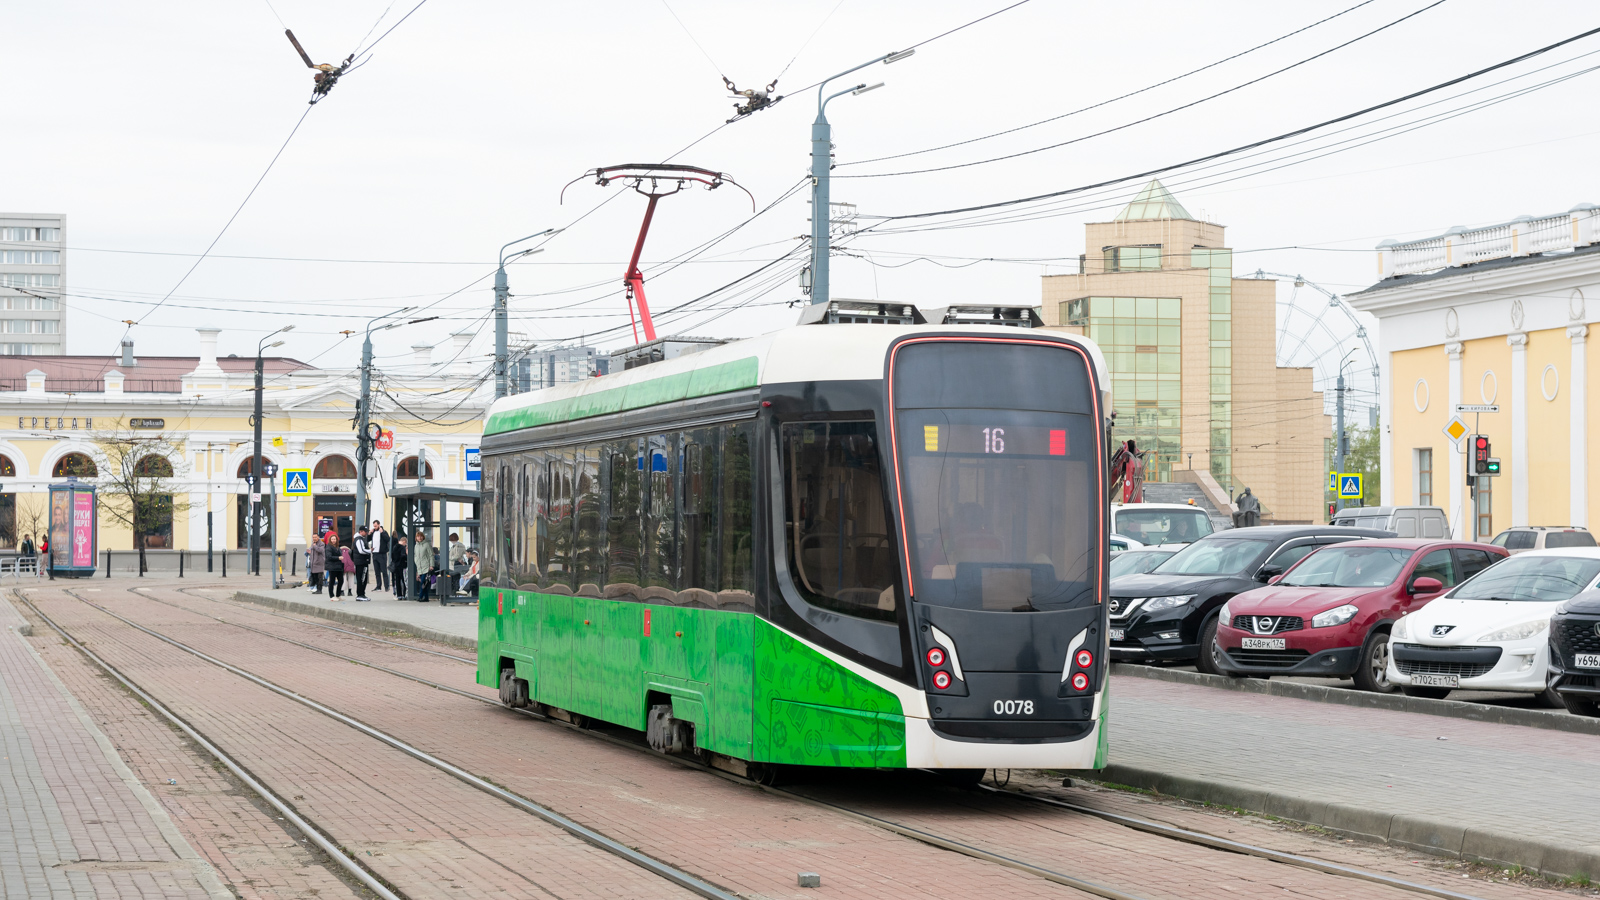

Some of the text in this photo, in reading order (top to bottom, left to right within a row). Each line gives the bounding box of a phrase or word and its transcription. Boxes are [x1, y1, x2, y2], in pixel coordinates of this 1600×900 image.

[18, 417, 92, 430] ЕРЕВАН
[982, 427, 1005, 454] 16
[74, 510, 90, 520] РУКИ
[1272, 639, 1284, 647] 174
[993, 699, 1034, 715] 0078
